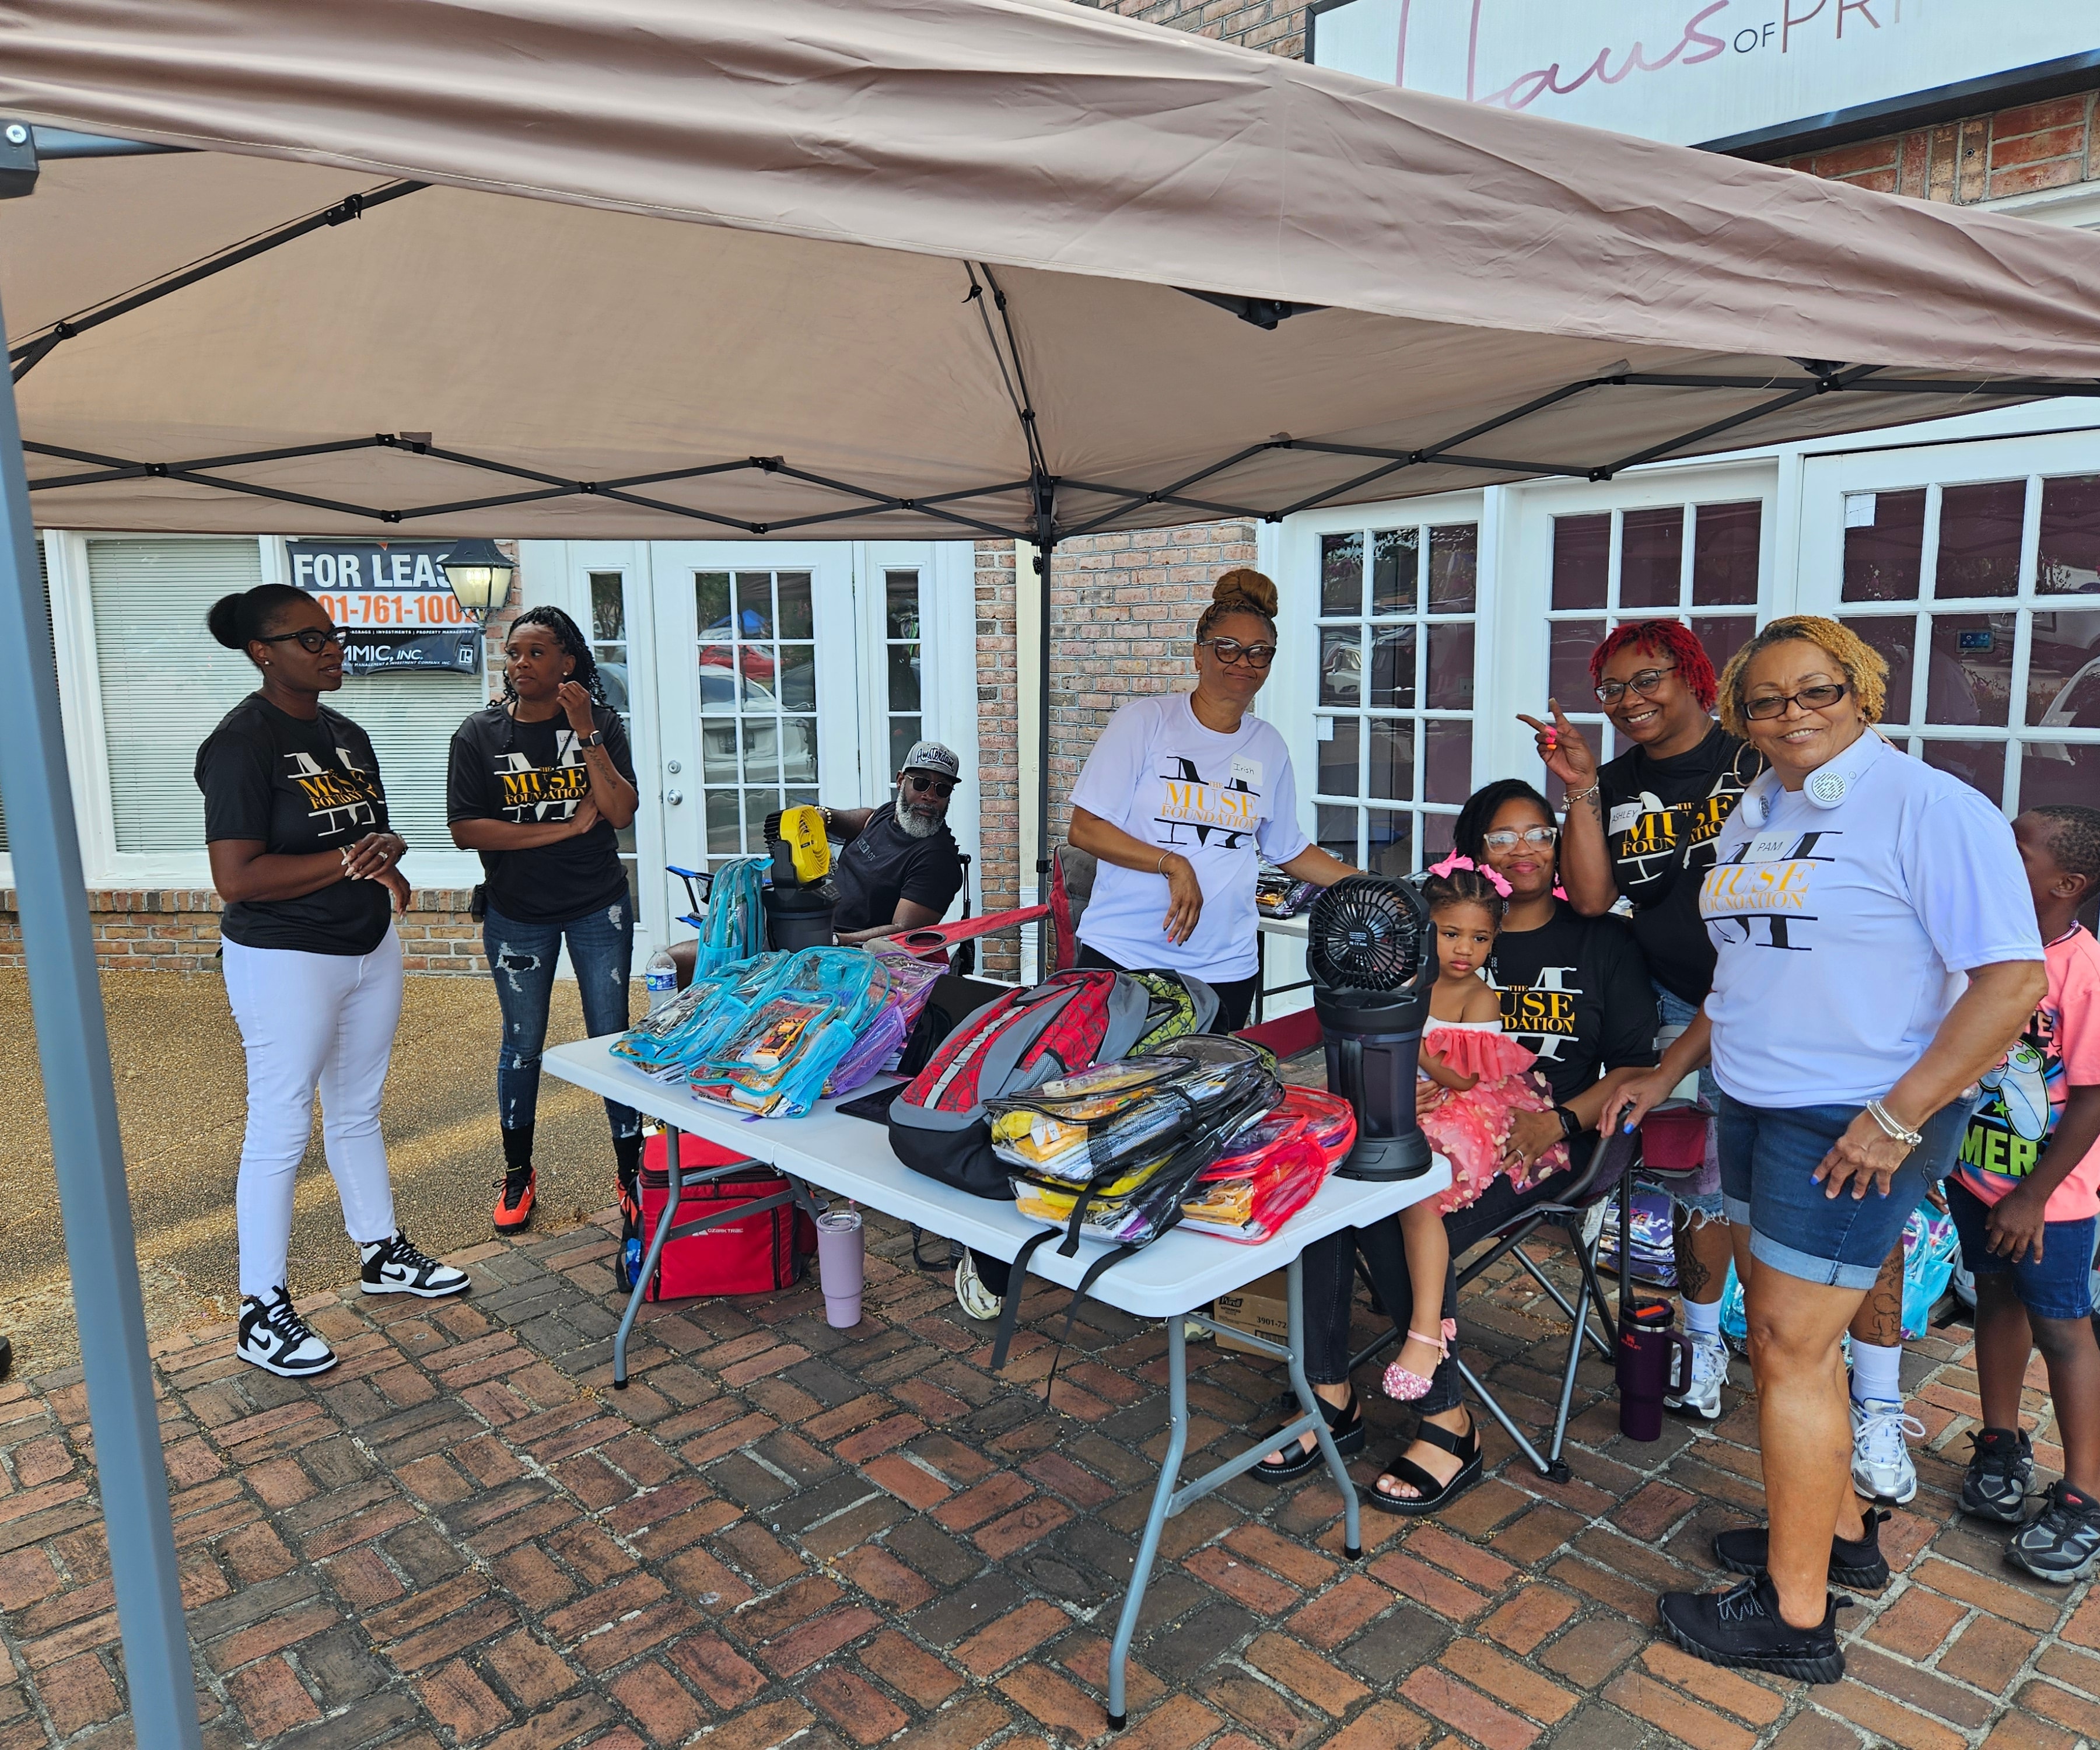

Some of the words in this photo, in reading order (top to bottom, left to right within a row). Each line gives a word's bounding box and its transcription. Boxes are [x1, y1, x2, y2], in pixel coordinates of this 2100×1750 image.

[1734, 22, 1775, 53] OF
[293, 554, 362, 587] FOR
[397, 649, 424, 660] INC.
[915, 747, 955, 769] Amsterdam
[1233, 763, 1254, 775] Irish
[1208, 780, 1224, 789] THE
[1163, 782, 1258, 820] MUSE
[1161, 804, 1255, 830] FOUNDATION
[1611, 809, 1639, 824] ASHLEY
[1757, 841, 1784, 852] PAM
[1705, 862, 1817, 897] MUSE
[1494, 992, 1575, 1021] USE
